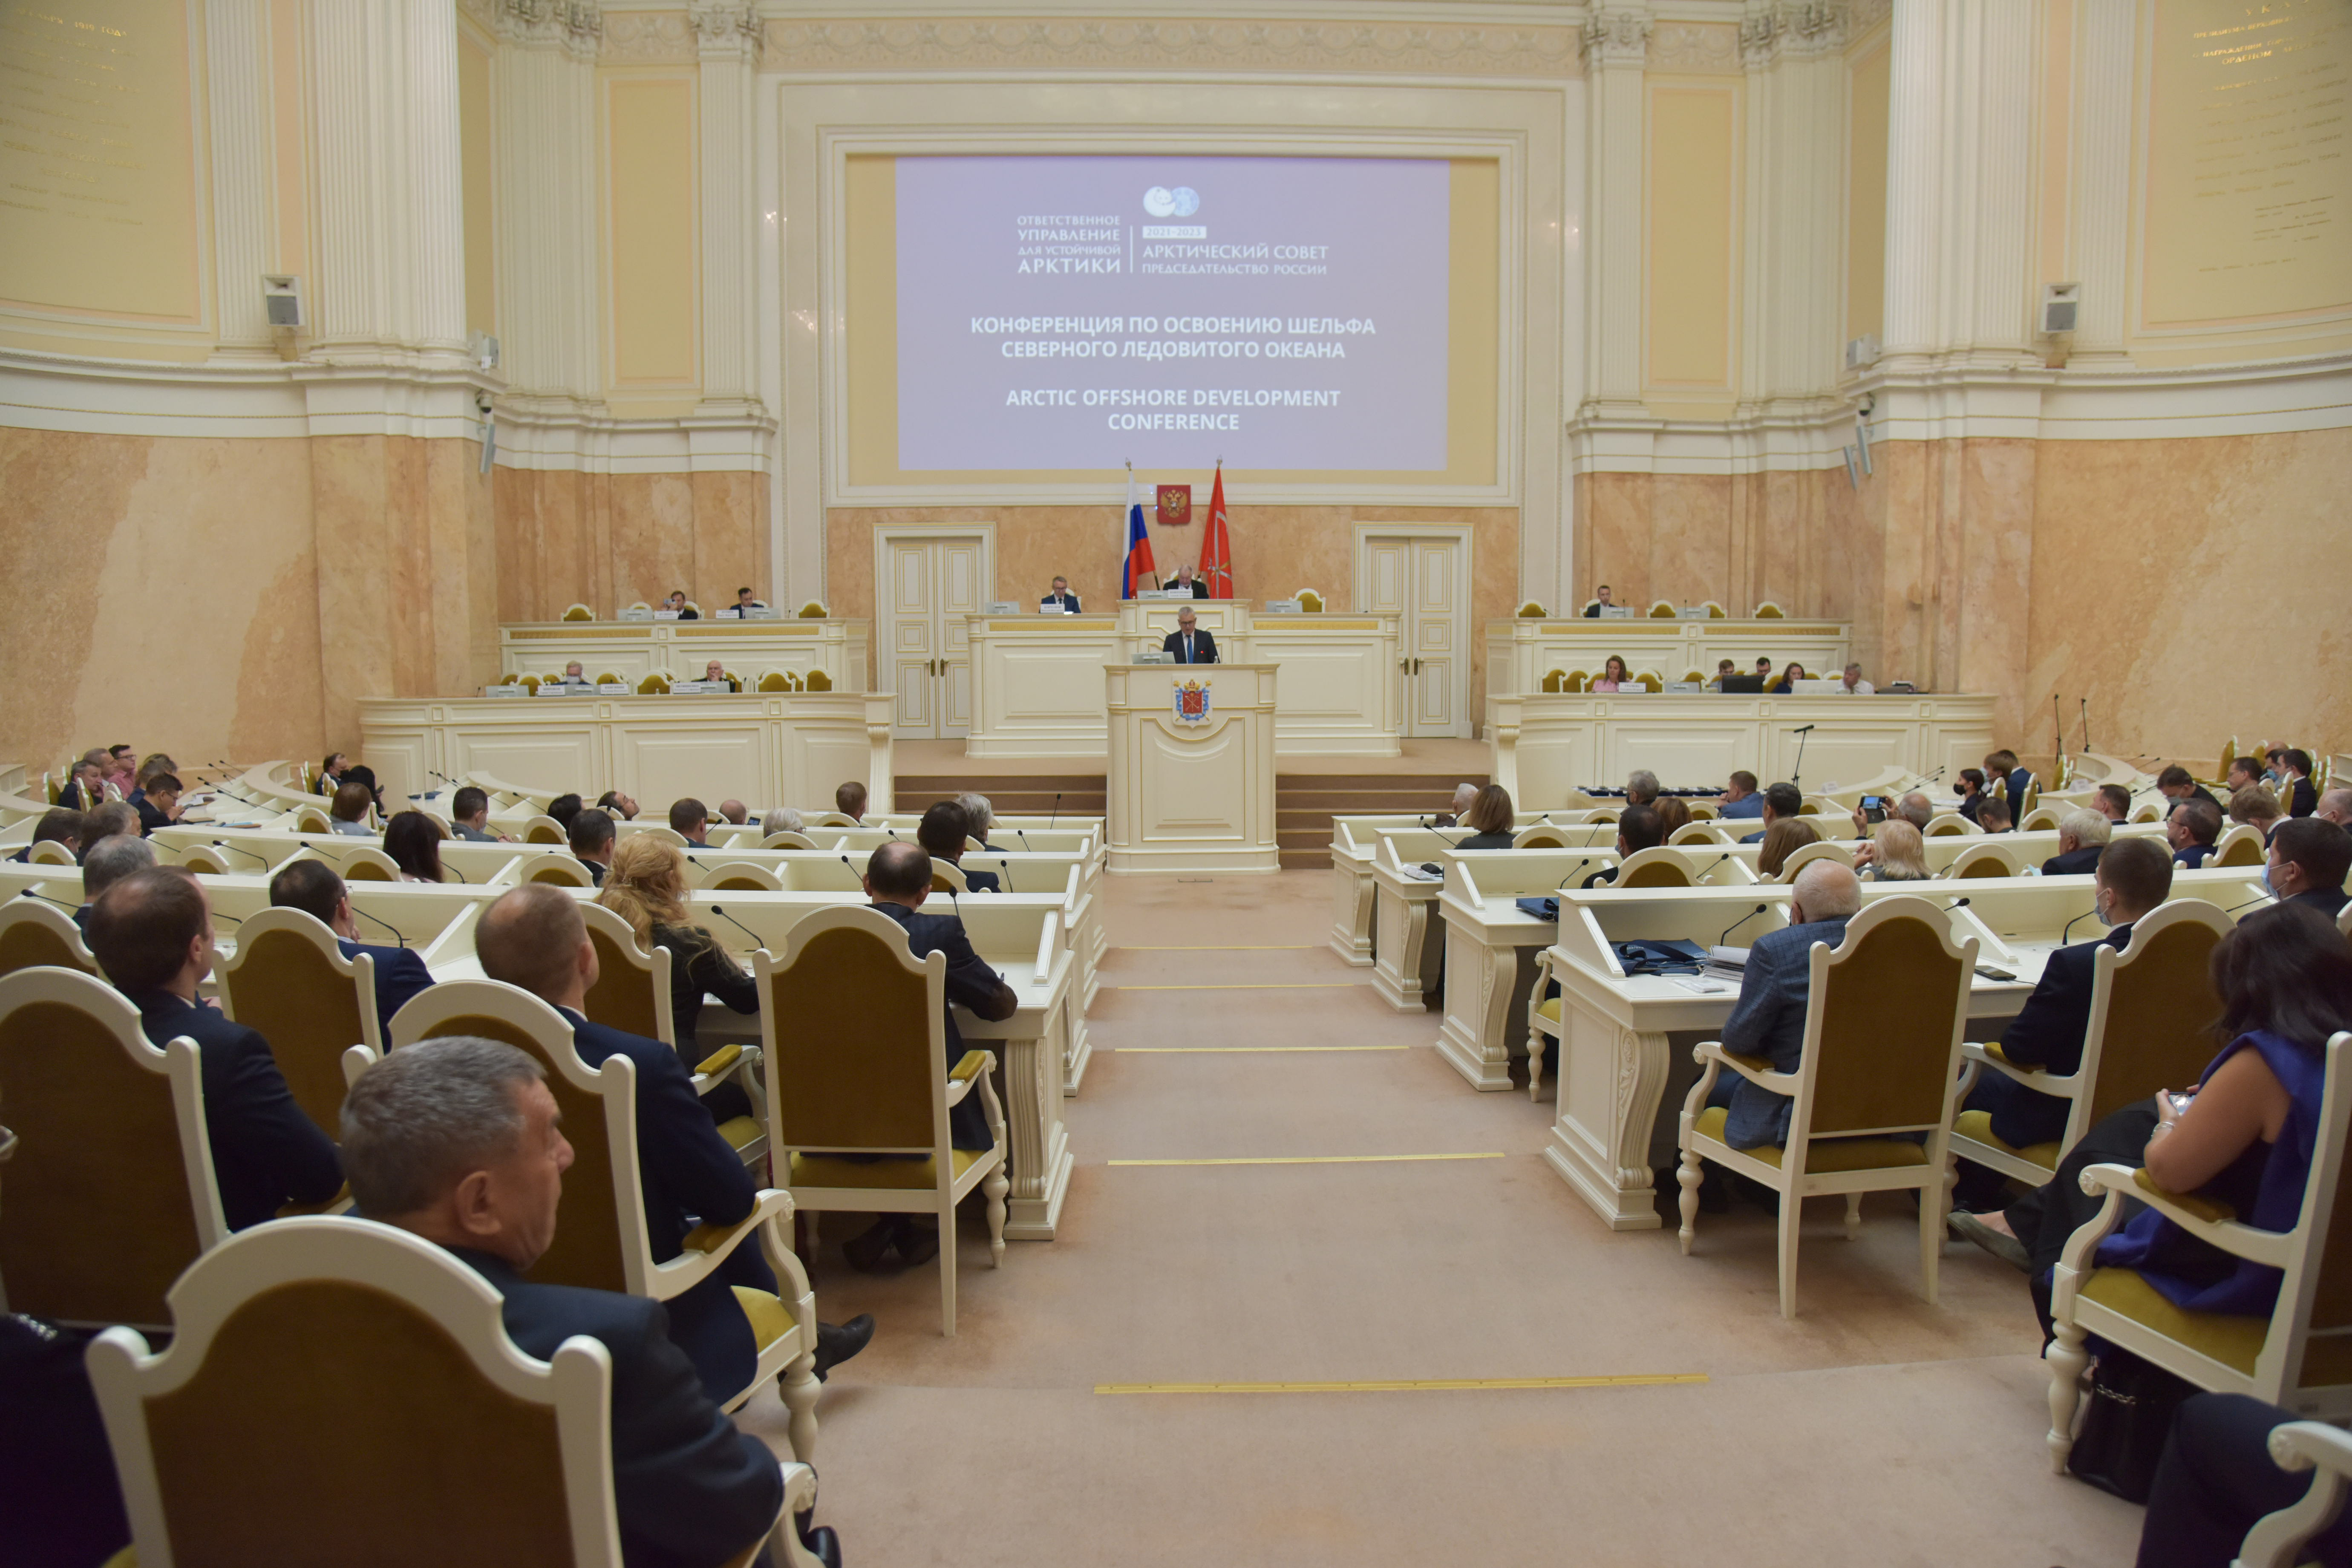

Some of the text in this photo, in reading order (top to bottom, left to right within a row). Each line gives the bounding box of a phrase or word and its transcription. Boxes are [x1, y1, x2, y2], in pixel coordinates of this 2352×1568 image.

[75, 21, 95, 31] 1919
[101, 26, 127, 37] ГОДА
[2222, 50, 2272, 65] ОРДЕНОМ
[1017, 216, 1119, 225] ОТВЕТСТВЕННОЕ
[1018, 230, 1119, 240] УПРАВЛЕНИЕ
[1018, 244, 1120, 255] ДЛЯ УСТОЙЧИВОЙ
[1143, 243, 1329, 259] АРКТИЧЕСКИЙ СОВЕТ
[1018, 259, 1120, 273] АРКТИКИ
[1143, 264, 1326, 274] ПРЕДСЕДАТЕЛЬСТВО РОССИИ
[972, 317, 1375, 336] КОНФЕРЕНЦИЯ ПО ОСВОЕНИЮ ШЕЛЬФА
[1002, 341, 1345, 361] СЕВЕРНОГО ЛЕДОВИТОГО ОКЕАНА
[1006, 390, 1340, 406] ARCTIC OFFSHORE DEVELOPMENT
[1108, 414, 1239, 430] CONFERENCE
